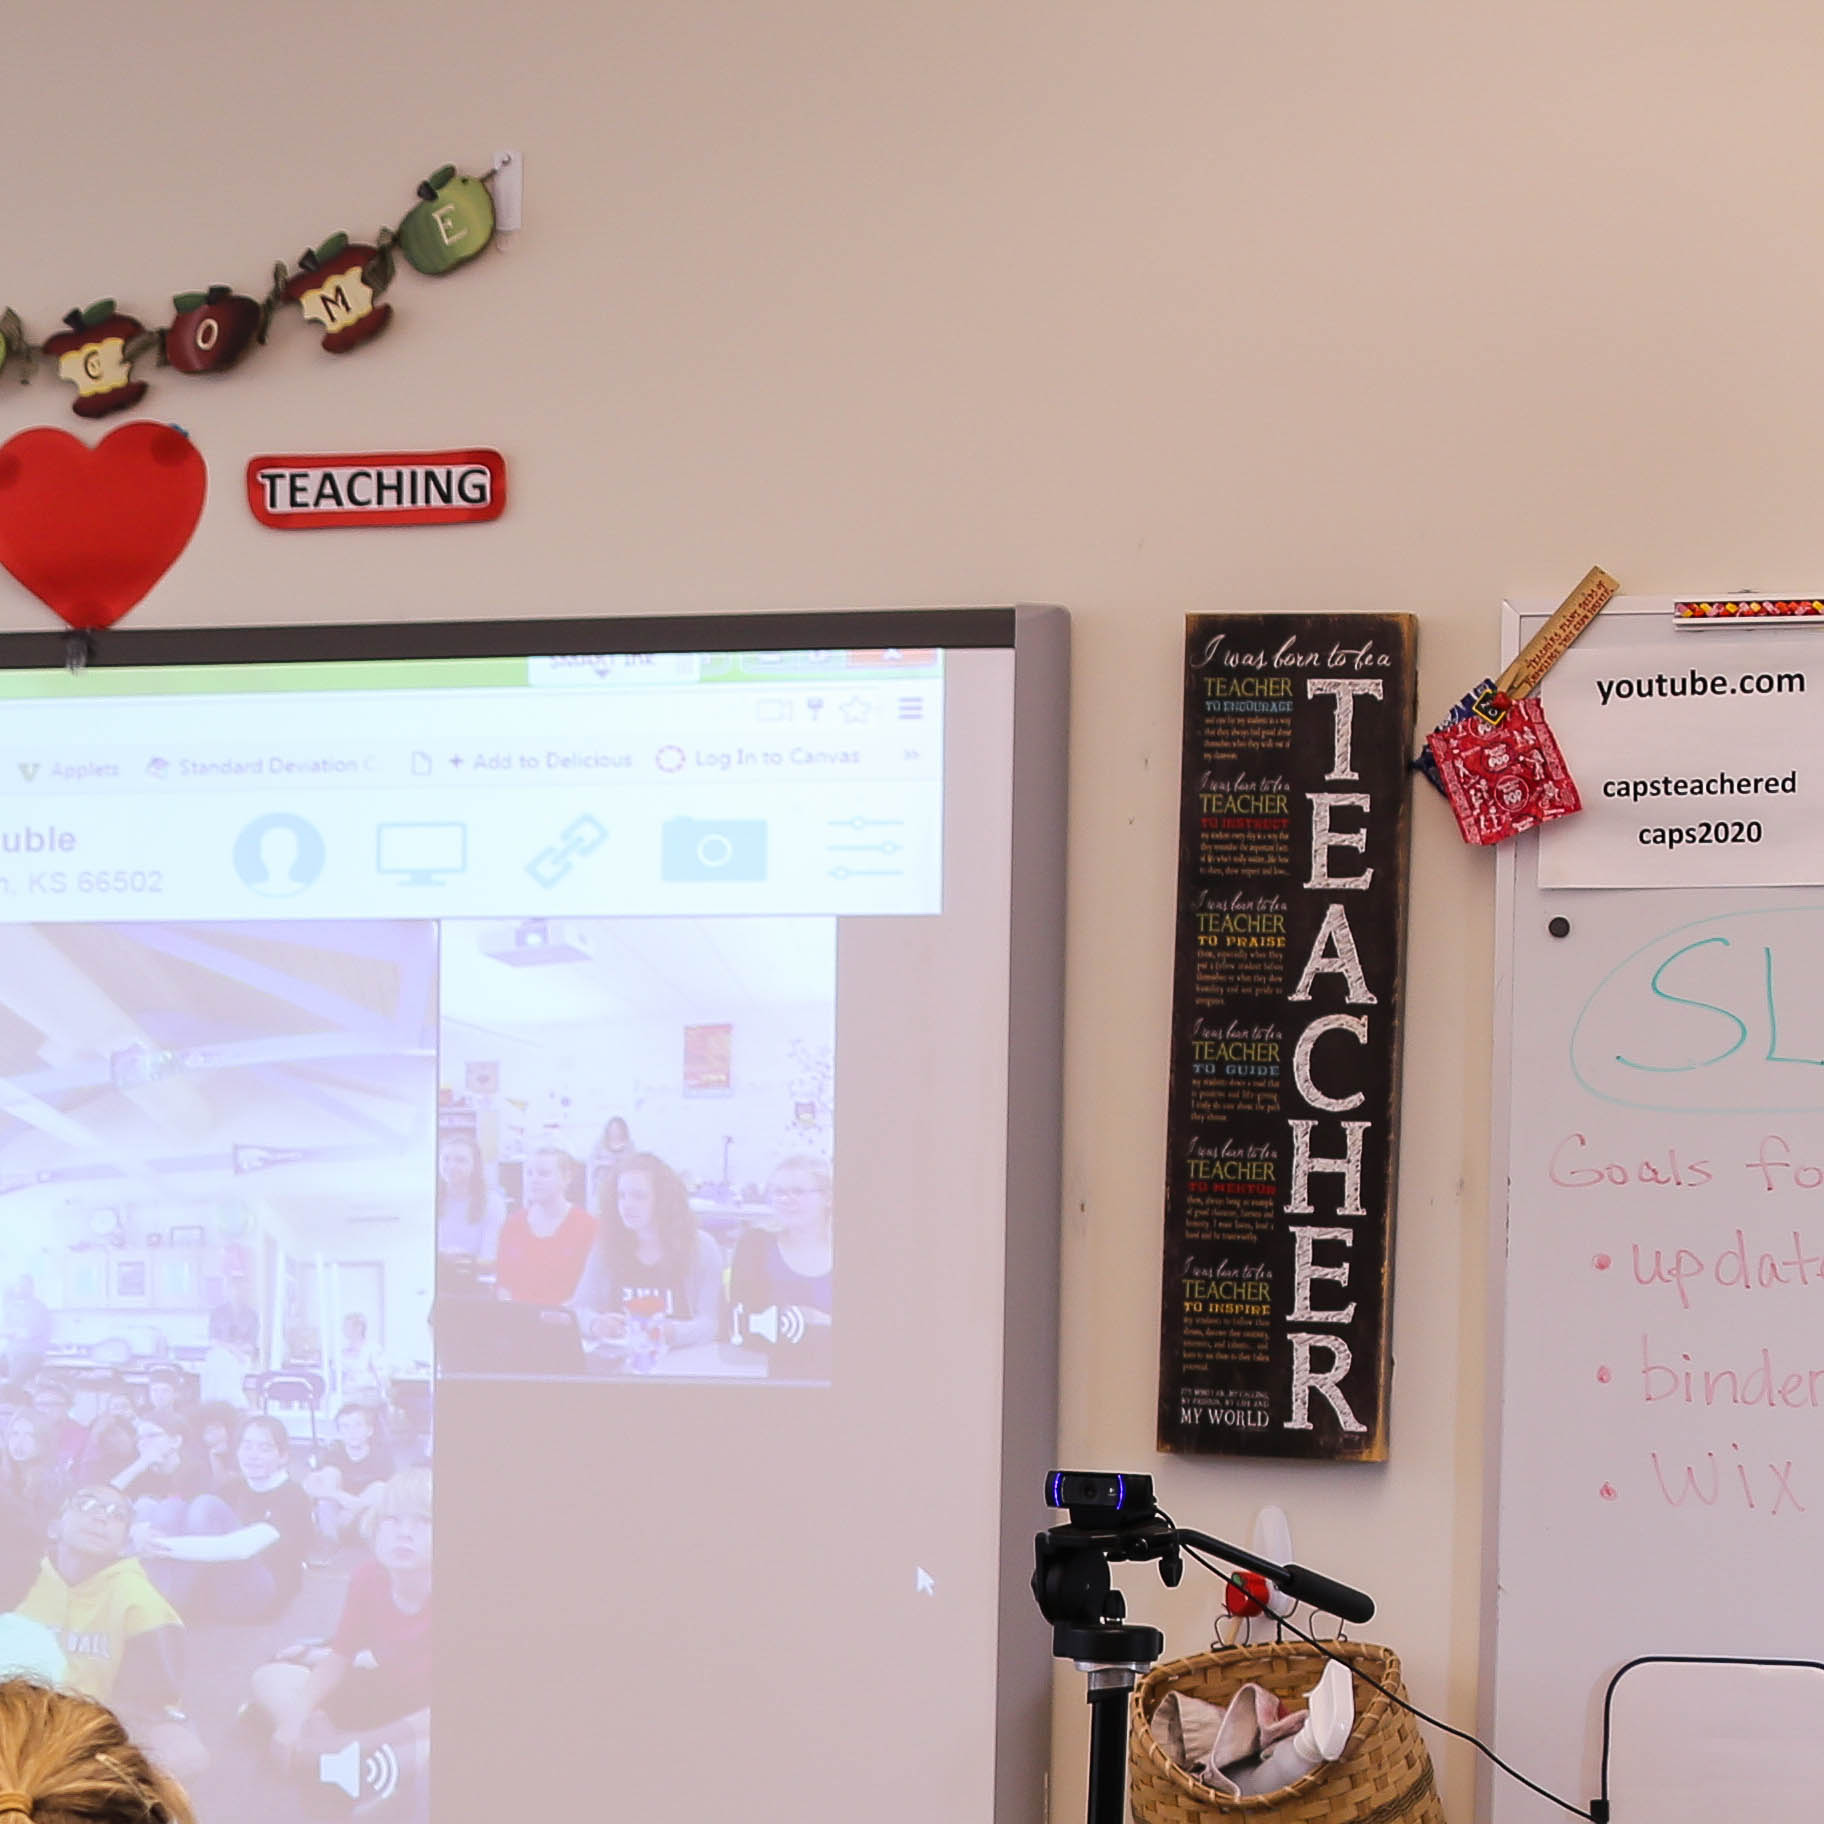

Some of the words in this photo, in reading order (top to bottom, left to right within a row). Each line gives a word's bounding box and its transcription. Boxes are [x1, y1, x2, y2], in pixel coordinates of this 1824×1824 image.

[259, 467, 489, 512] TEACHING
[1191, 634, 1226, 668] I
[1224, 650, 1267, 670] was
[1274, 635, 1321, 668] born
[1327, 642, 1347, 668] to
[1377, 653, 1392, 667] a
[1204, 677, 1293, 697] TEACHER
[1597, 669, 1806, 703] youtube.com
[1603, 770, 1797, 802] capsteachered
[1200, 794, 1288, 814] TEACHER
[1639, 820, 1762, 848] caps2020
[28, 871, 67, 894] KS
[1196, 913, 1286, 933] TEACHER
[1197, 936, 1218, 946] TO
[1227, 936, 1287, 948] PRAISE
[1192, 1042, 1280, 1062] TEACHER
[1282, 679, 1384, 1432] TEACHER
[1193, 1064, 1215, 1074] TO
[1225, 1065, 1280, 1076] GUIDE
[1187, 1160, 1275, 1180] TEACHER
[1550, 1132, 1712, 1190] Goals
[1182, 1279, 1271, 1300] TEACHER
[1184, 1302, 1202, 1312] TO
[1209, 1302, 1272, 1315] INSPIRE
[1181, 1408, 1202, 1425] MY
[1208, 1409, 1269, 1428] WORLD
